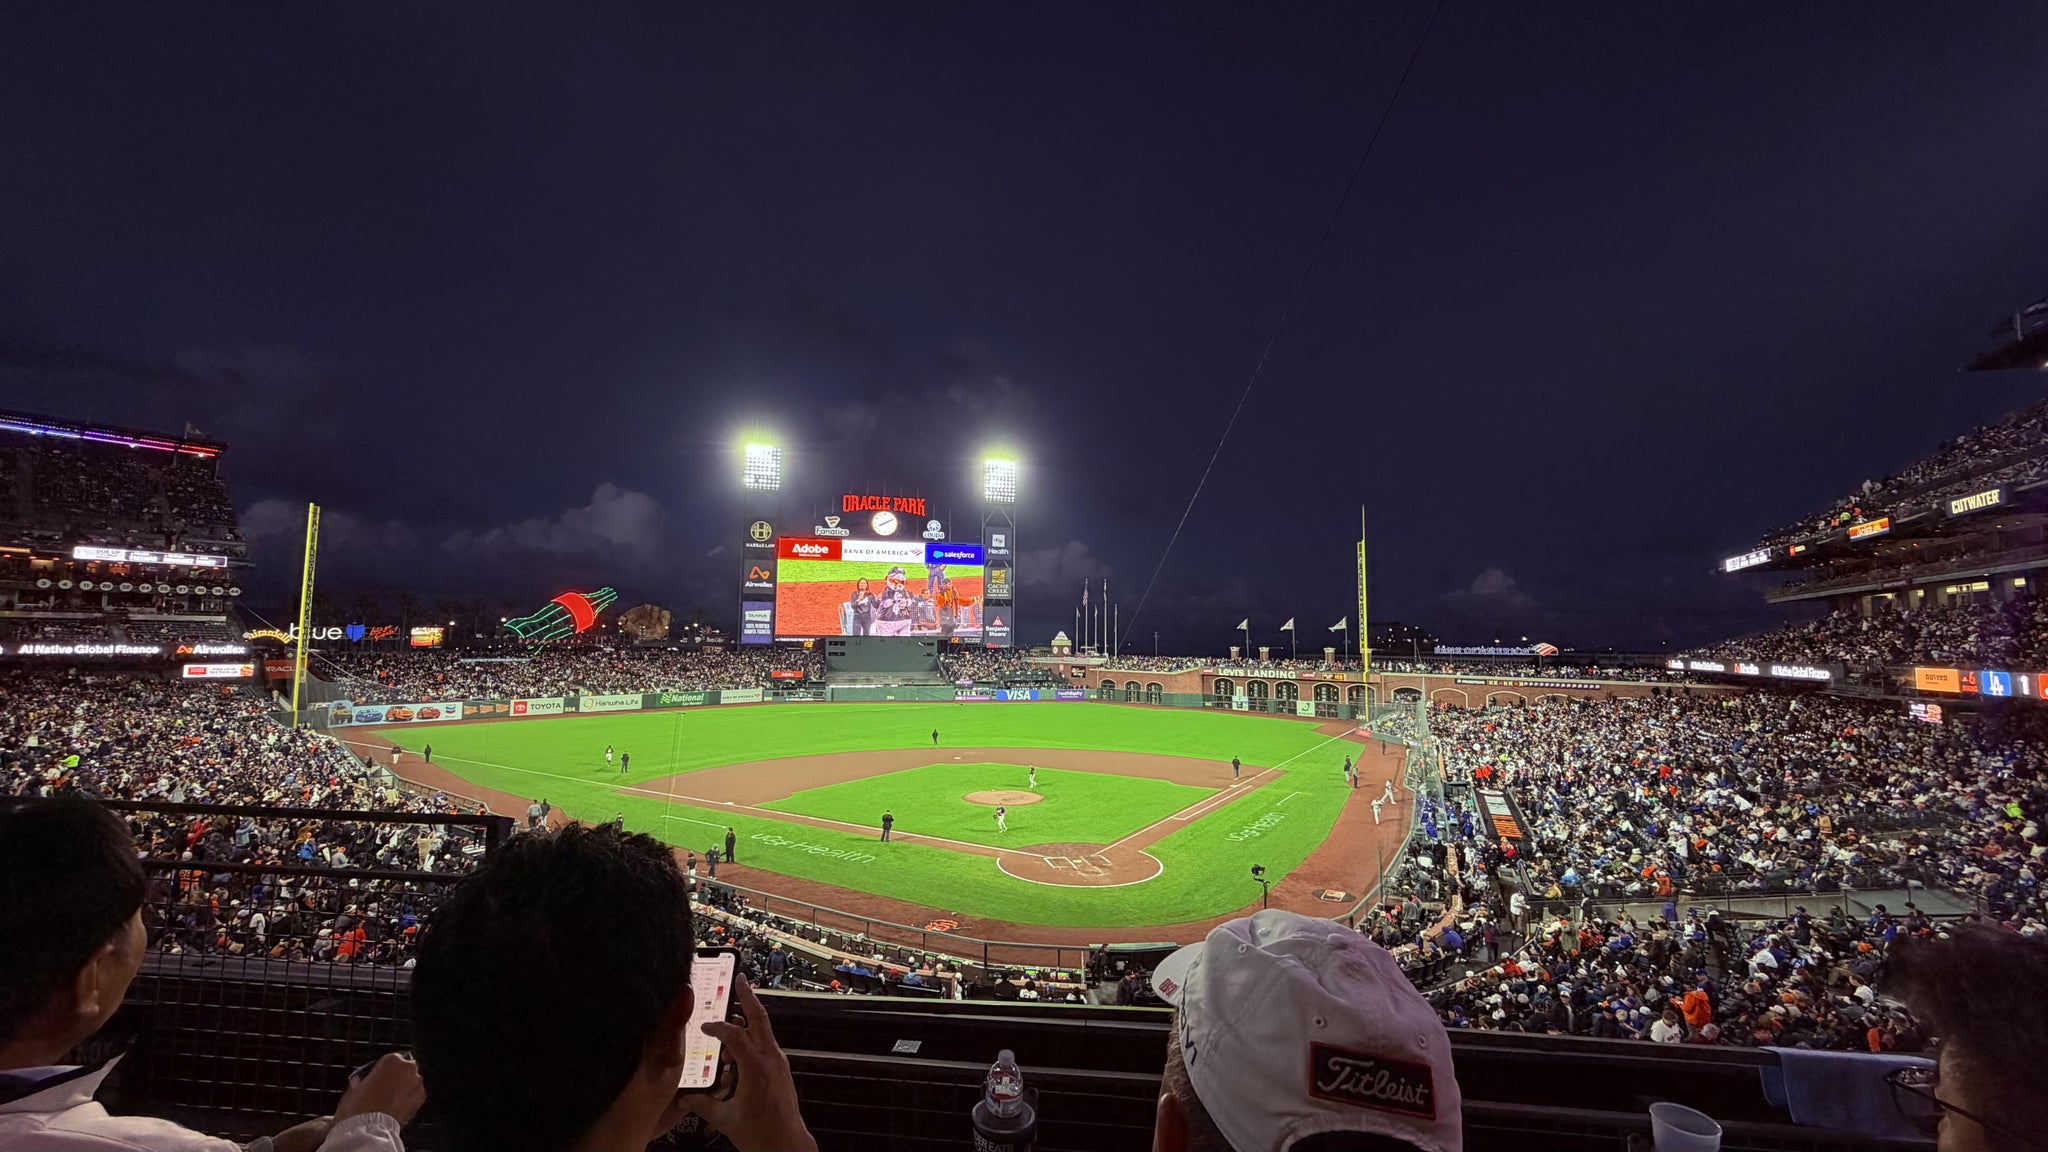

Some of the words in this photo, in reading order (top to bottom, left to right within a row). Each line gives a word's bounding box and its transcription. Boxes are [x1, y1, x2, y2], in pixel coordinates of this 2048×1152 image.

[842, 494, 890, 513] ORACLE
[893, 497, 926, 517] PARK
[1951, 489, 2000, 515] CUTWATER
[815, 526, 849, 537] Fanatics
[792, 543, 829, 554] Adobe
[944, 551, 975, 560] salesforce
[290, 622, 343, 640] bue
[986, 625, 1010, 633] Benjamin
[34, 644, 73, 654] Native
[74, 644, 114, 654] Global
[115, 644, 160, 654] Finance
[193, 644, 246, 654] Airwallex
[1247, 669, 1296, 679] LANDING
[2020, 675, 2030, 695] 1
[671, 693, 705, 702] National
[1006, 690, 1031, 700] VISA
[530, 702, 561, 711] TOYOTA
[787, 841, 876, 864] Health
[1317, 1056, 1429, 1105] Titleist
